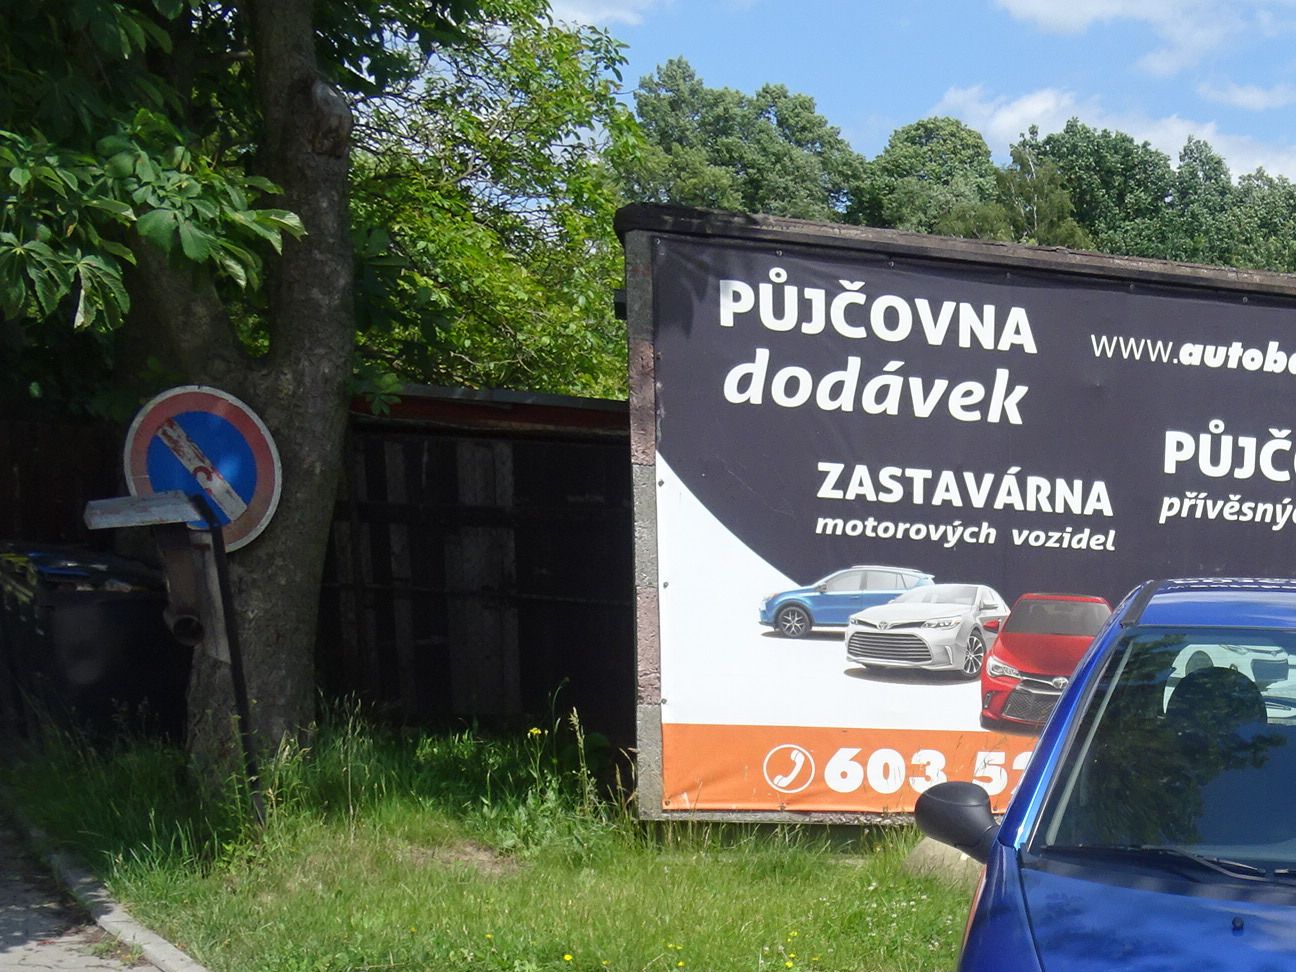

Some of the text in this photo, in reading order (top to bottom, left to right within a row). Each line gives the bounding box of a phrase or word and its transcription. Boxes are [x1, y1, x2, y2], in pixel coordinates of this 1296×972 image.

[720, 267, 1038, 354] PŮJČOVNA
[724, 348, 1029, 425] dodávek
[817, 461, 1114, 517] ZASTAVÁRNA
[815, 516, 1116, 552] motorových vozidel
[824, 747, 947, 795] 603
